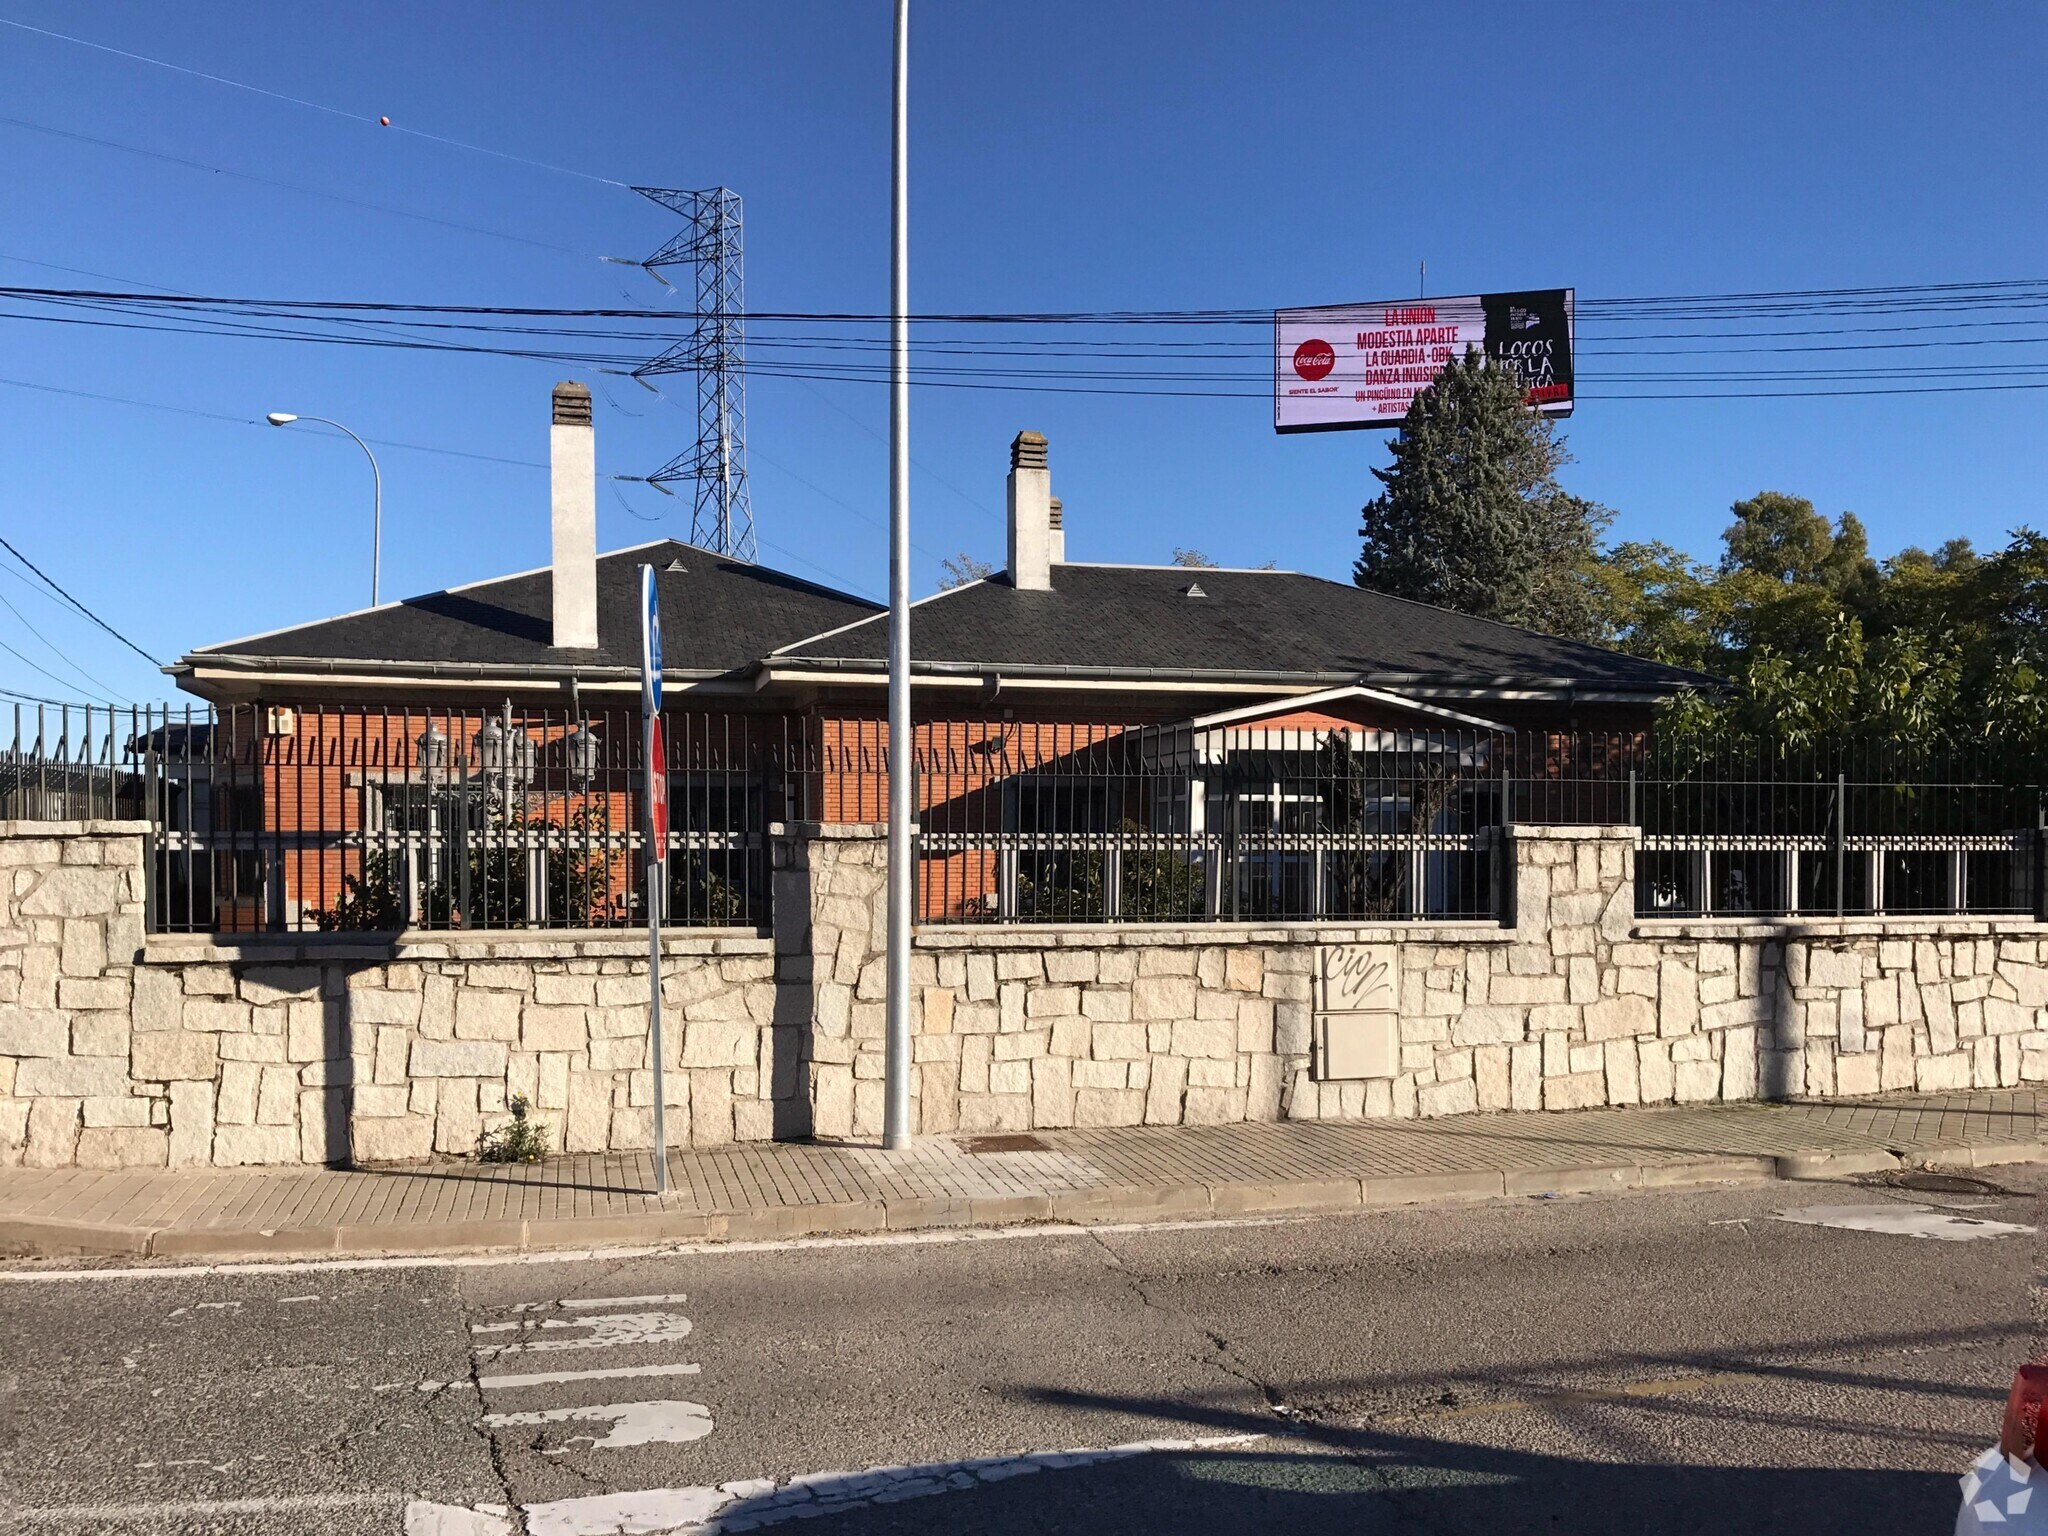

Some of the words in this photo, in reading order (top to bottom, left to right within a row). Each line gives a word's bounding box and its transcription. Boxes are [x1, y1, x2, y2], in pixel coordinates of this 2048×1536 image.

[1385, 309, 1399, 326] LA
[1357, 330, 1413, 350] MODESTIA
[1416, 326, 1459, 346] APARTE
[1366, 351, 1378, 367] LA
[1381, 348, 1425, 366] GUARDIA
[1499, 339, 1553, 358] LOCOS
[1528, 357, 1554, 375] LA
[1366, 367, 1400, 386] DANZA
[1356, 390, 1366, 402] UN
[1367, 387, 1401, 402] PINGÜINO
[1403, 387, 1412, 399] EN
[1378, 402, 1409, 414] ARTISTAS
[653, 771, 666, 805] STOP
